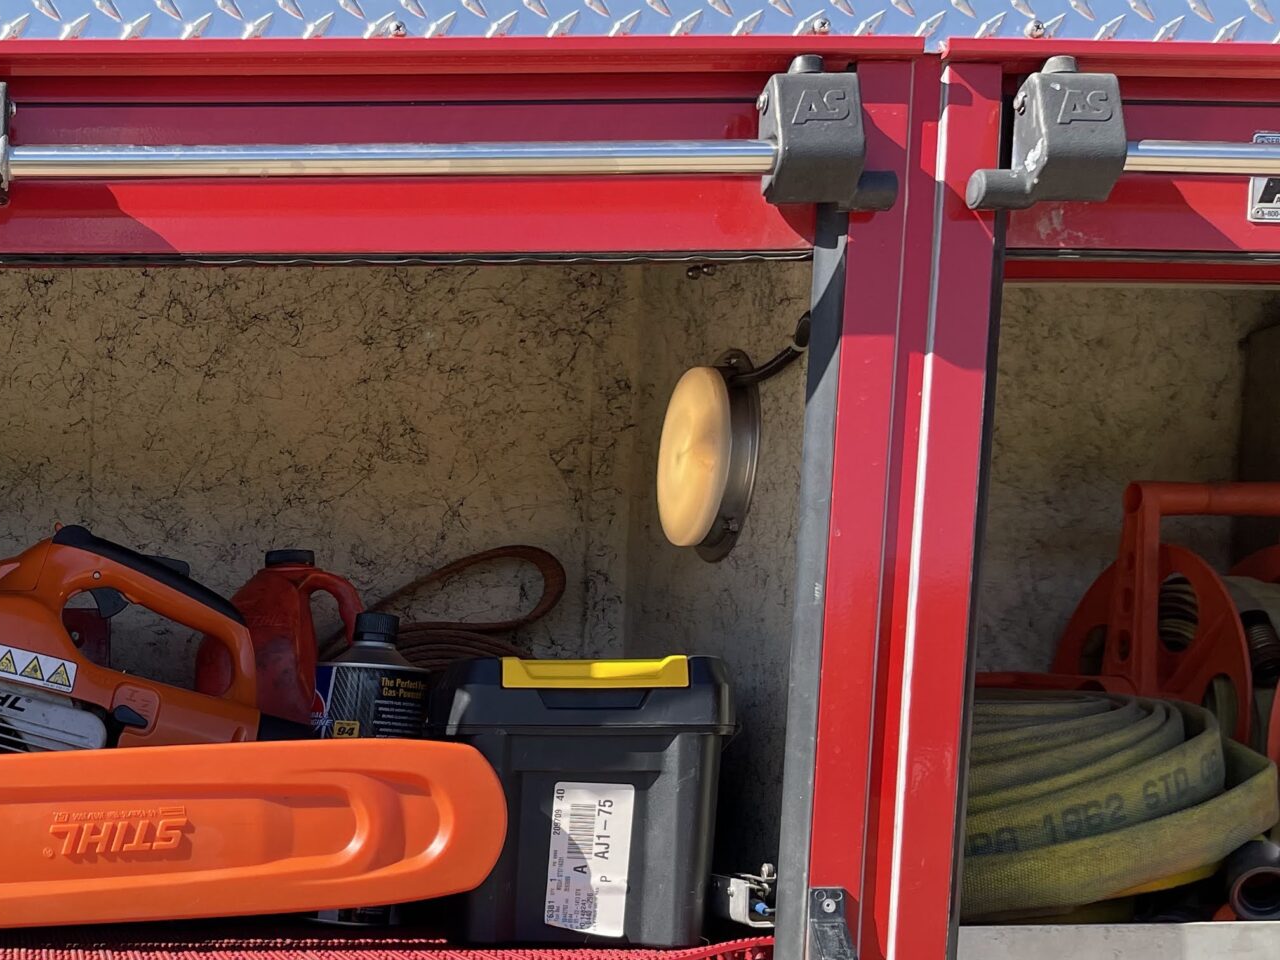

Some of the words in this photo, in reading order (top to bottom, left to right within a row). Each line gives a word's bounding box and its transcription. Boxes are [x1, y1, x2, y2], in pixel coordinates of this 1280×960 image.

[792, 89, 851, 125] AS
[1057, 89, 1114, 125] AS
[555, 788, 566, 801] 40
[49, 817, 189, 855] STIHL
[573, 864, 588, 874] A
[600, 875, 612, 883] P
